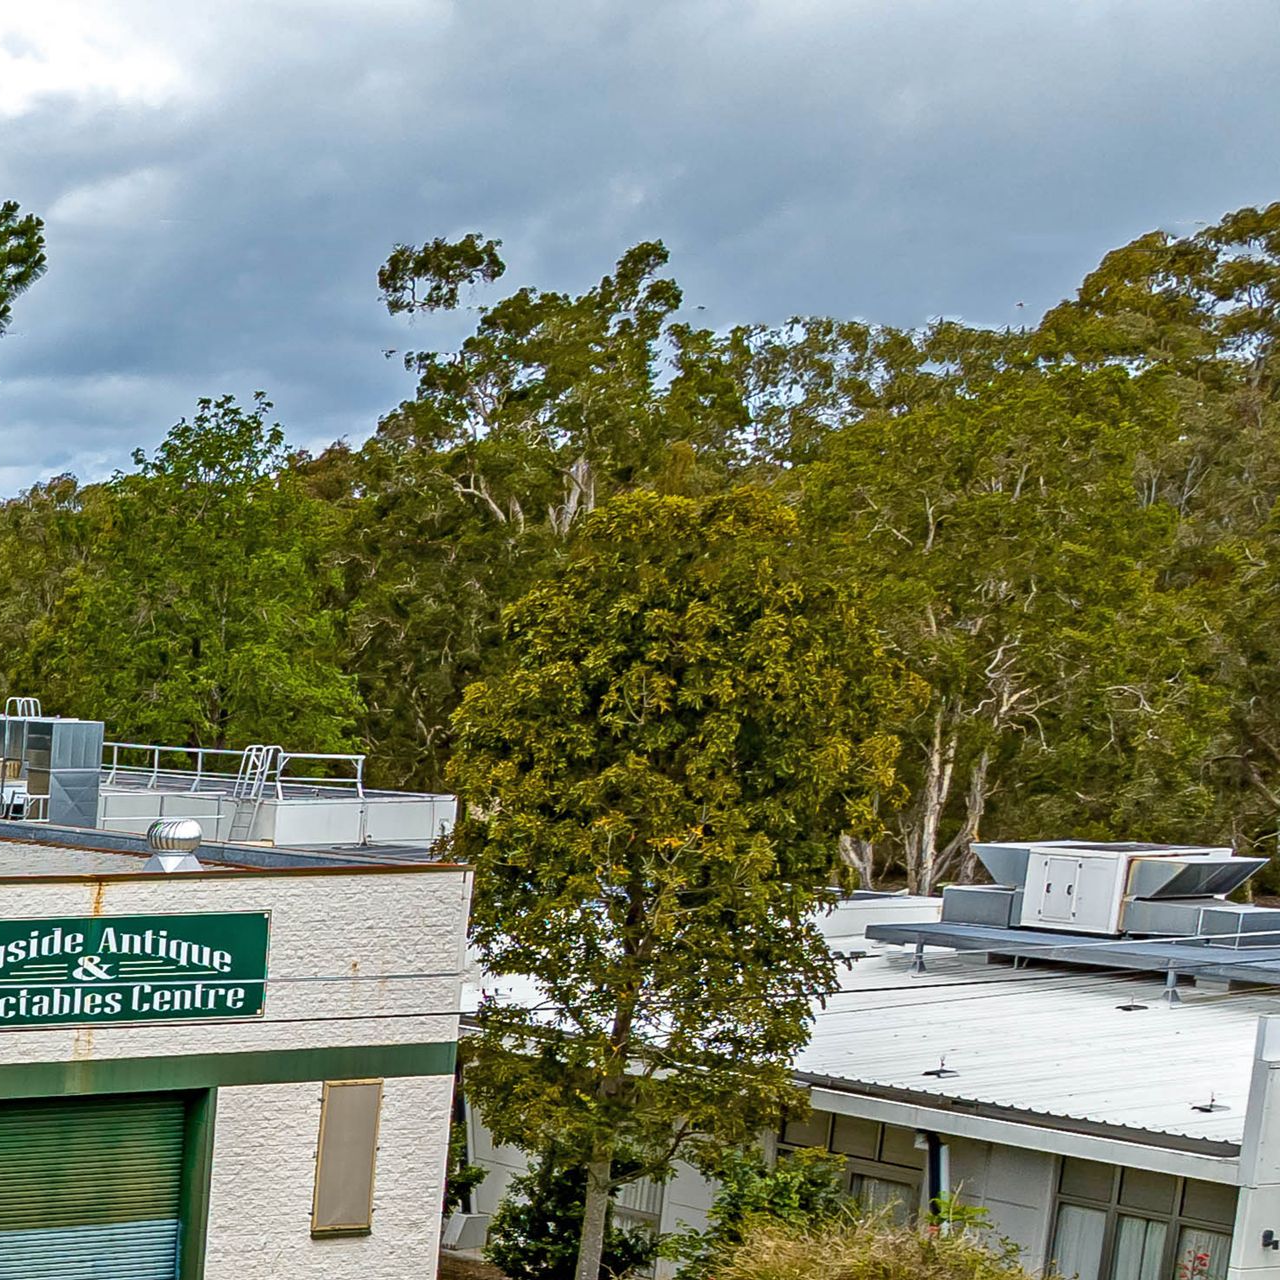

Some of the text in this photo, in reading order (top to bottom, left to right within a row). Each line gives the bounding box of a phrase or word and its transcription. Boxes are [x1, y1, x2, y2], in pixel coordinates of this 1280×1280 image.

[98, 927, 232, 974] Antique
[71, 955, 117, 981] &
[131, 984, 245, 1013] Centre
